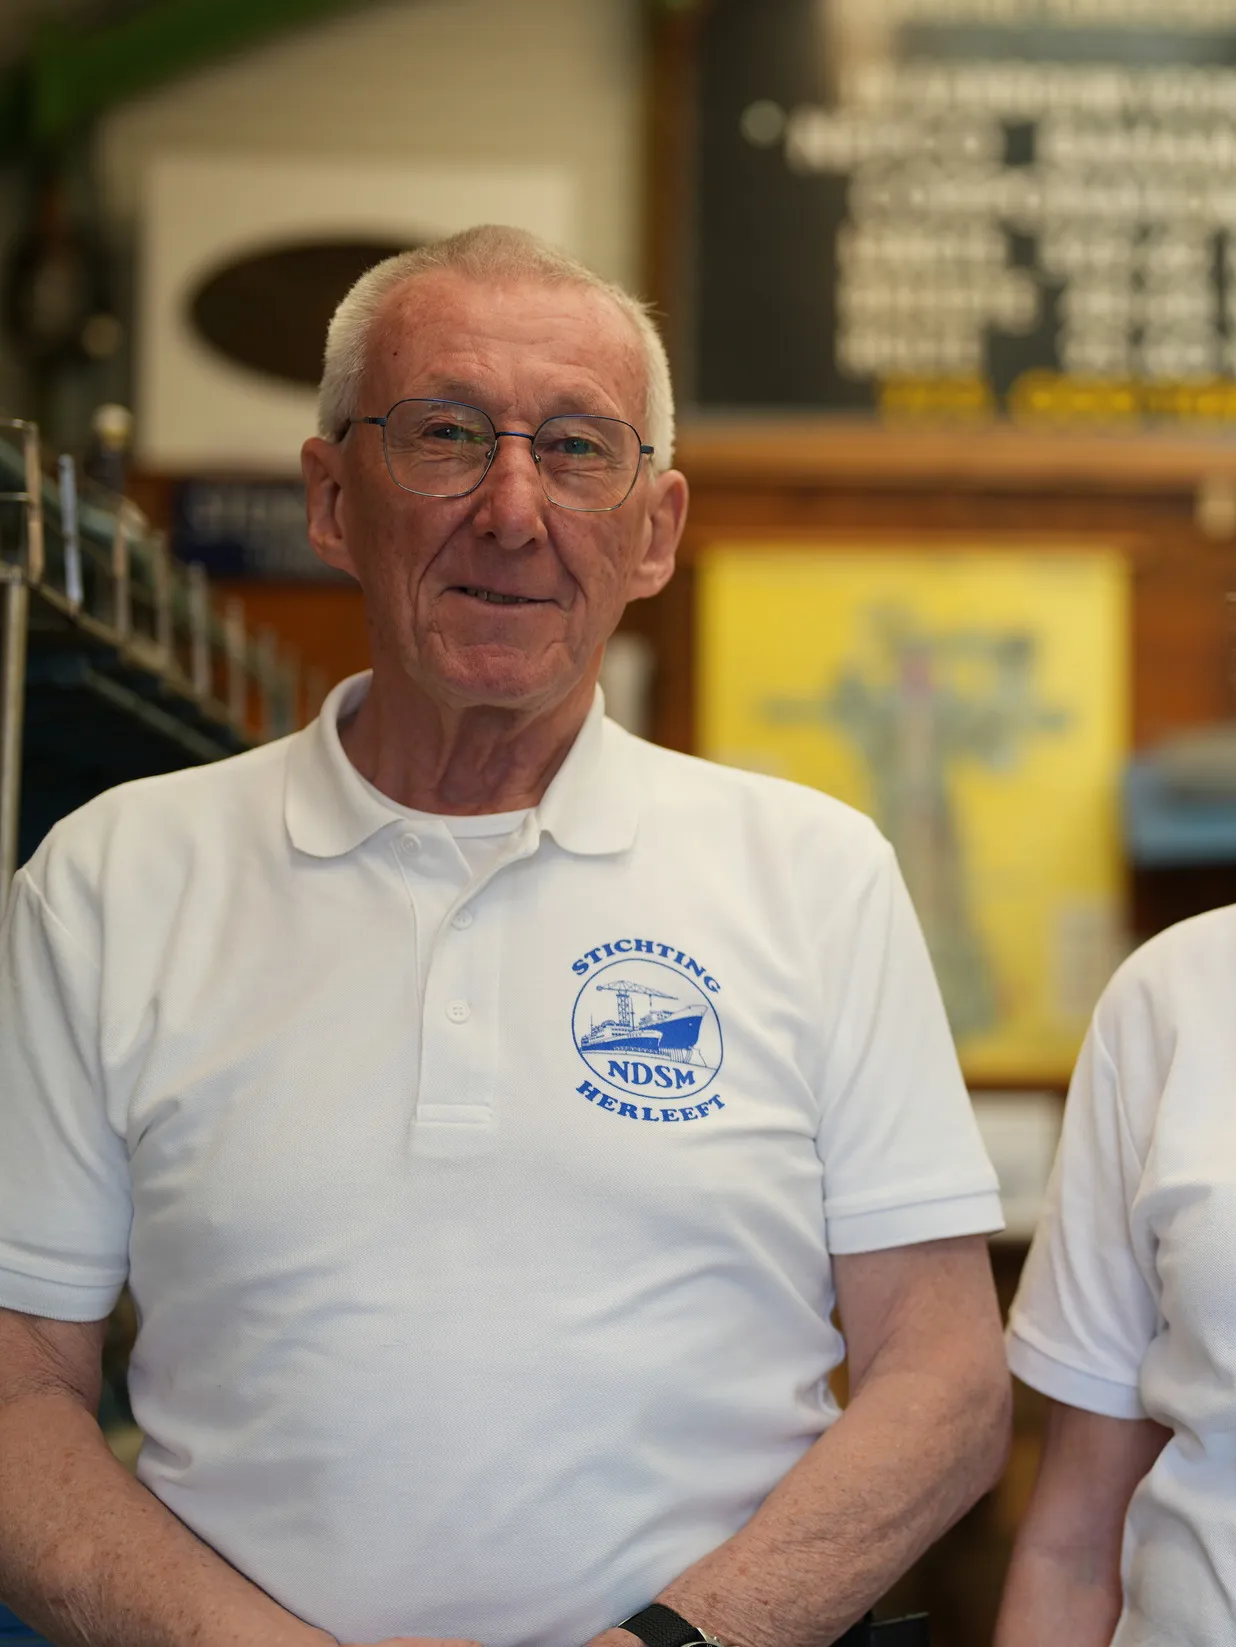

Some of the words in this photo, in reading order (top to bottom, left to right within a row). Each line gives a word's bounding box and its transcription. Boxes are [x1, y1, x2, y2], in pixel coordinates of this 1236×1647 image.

[571, 938, 721, 993] STICHTING
[608, 1060, 695, 1089] NDSM
[575, 1079, 725, 1122] HERLEEFT
